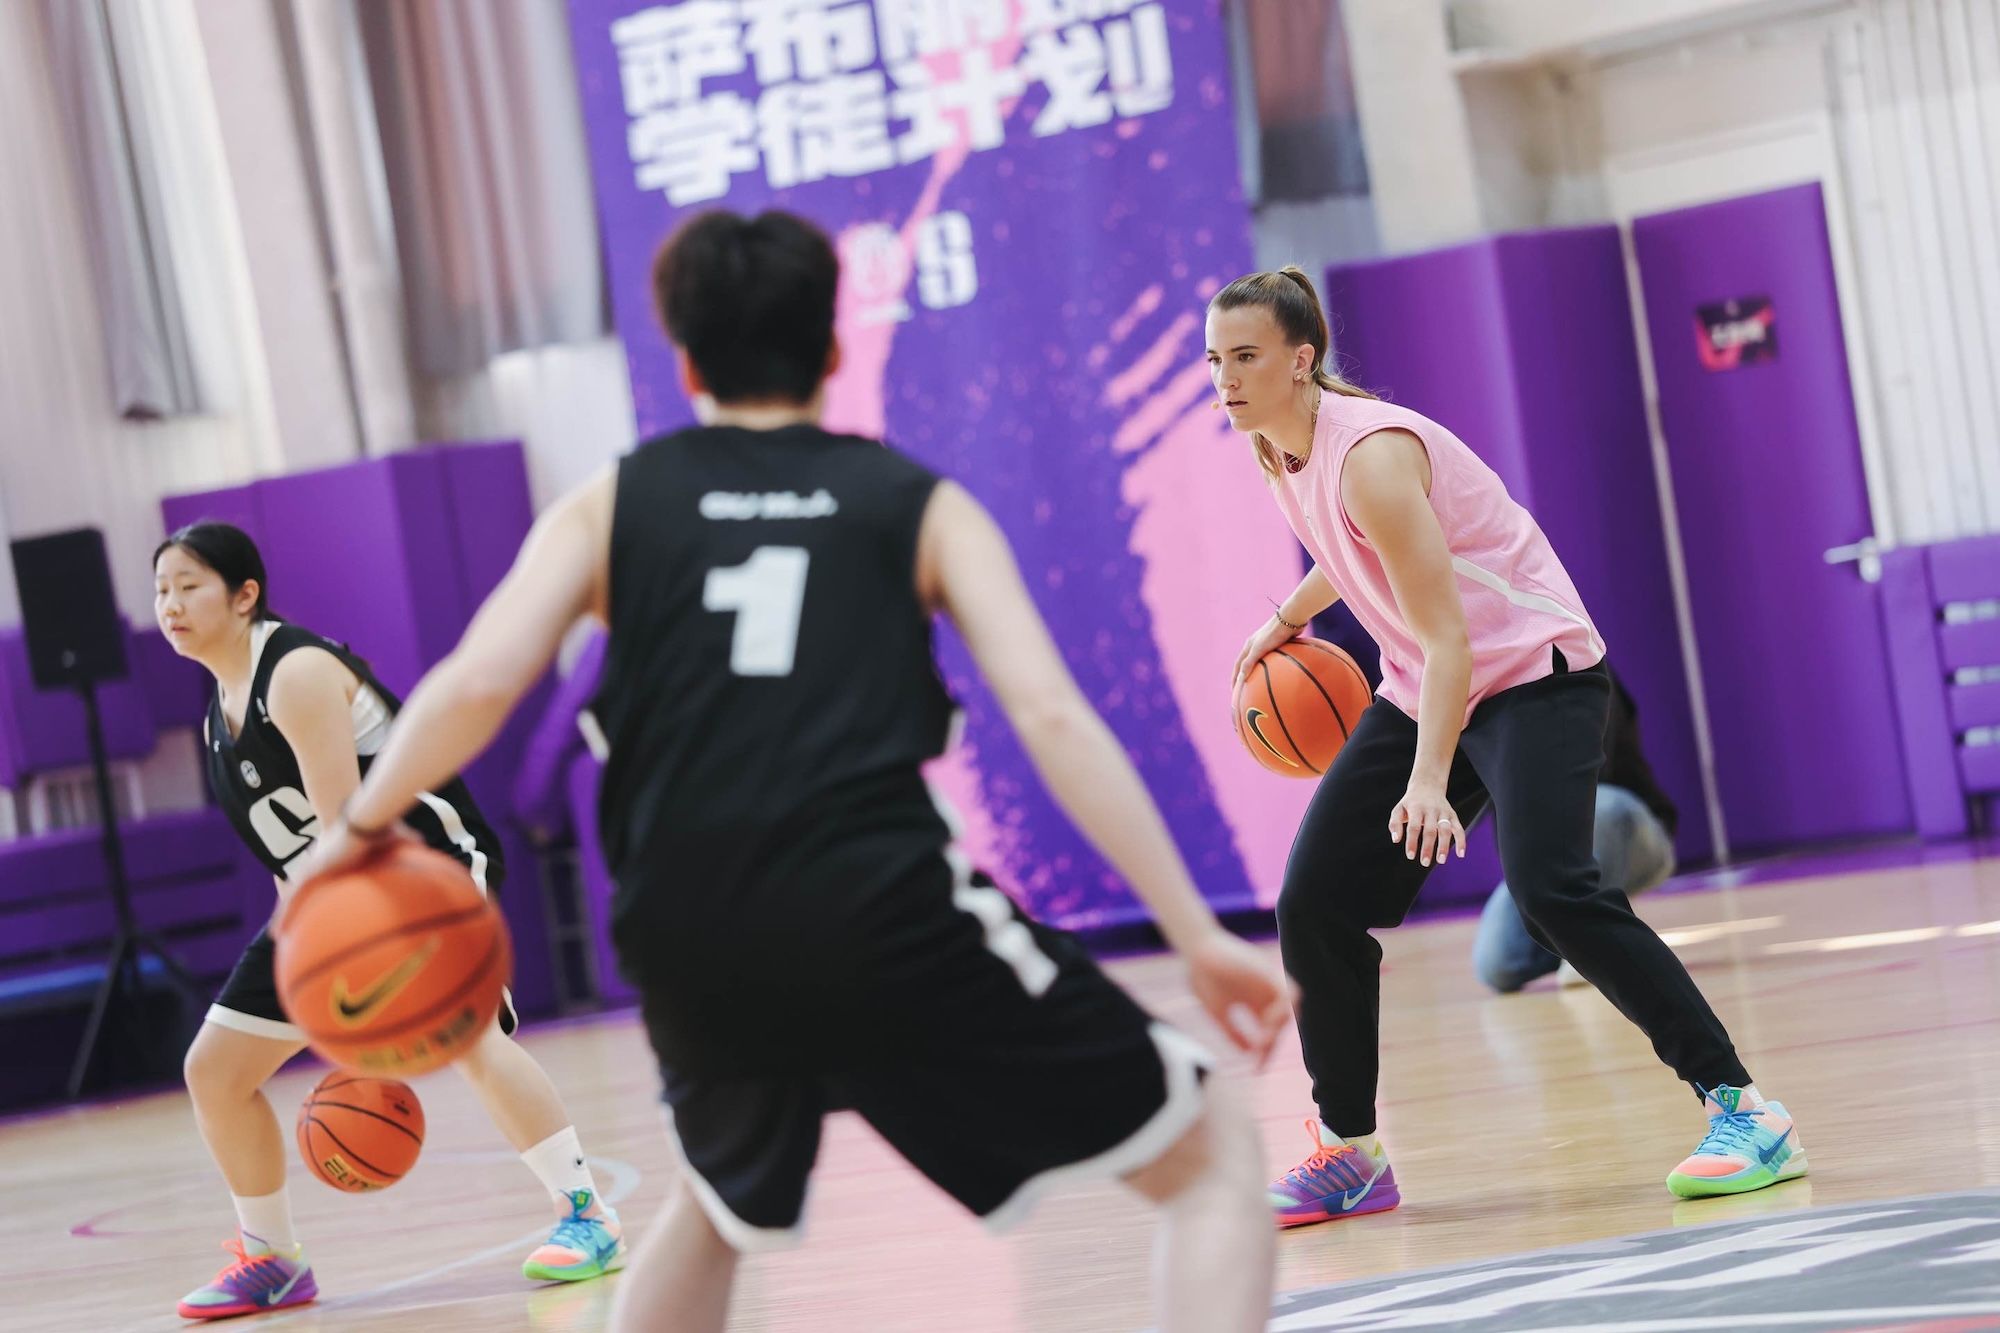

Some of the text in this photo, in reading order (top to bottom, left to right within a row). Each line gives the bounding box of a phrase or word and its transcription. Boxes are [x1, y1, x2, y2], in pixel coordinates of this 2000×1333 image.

[627, 3, 1176, 208] 学徒计划
[702, 545, 811, 678] 1
